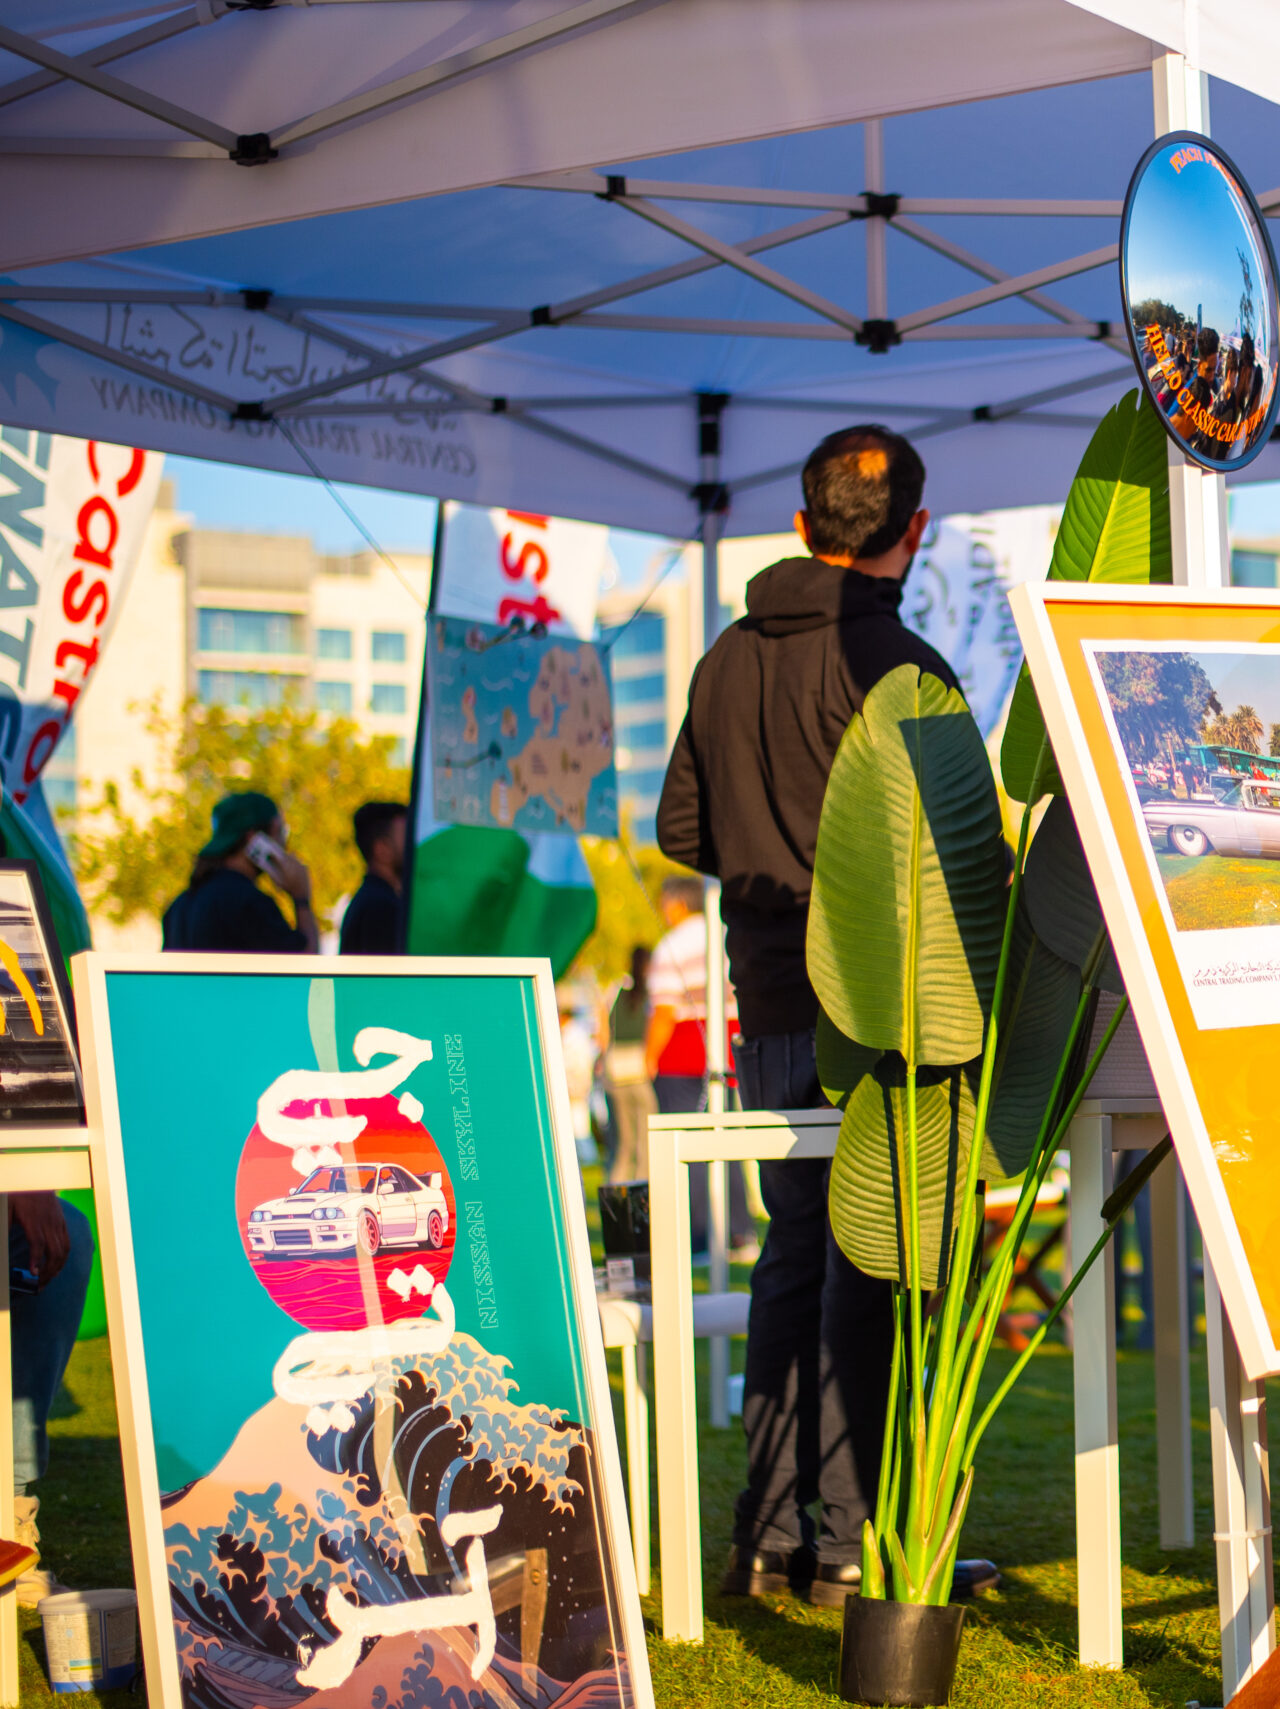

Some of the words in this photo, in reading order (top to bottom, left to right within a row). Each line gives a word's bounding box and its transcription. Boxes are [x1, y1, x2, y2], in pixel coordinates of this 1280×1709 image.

[1145, 321, 1183, 391] HELLO
[1176, 388, 1221, 438] CLASSIC
[443, 1034, 480, 1181] SKYLINE
[465, 1200, 499, 1329] NISSAN
